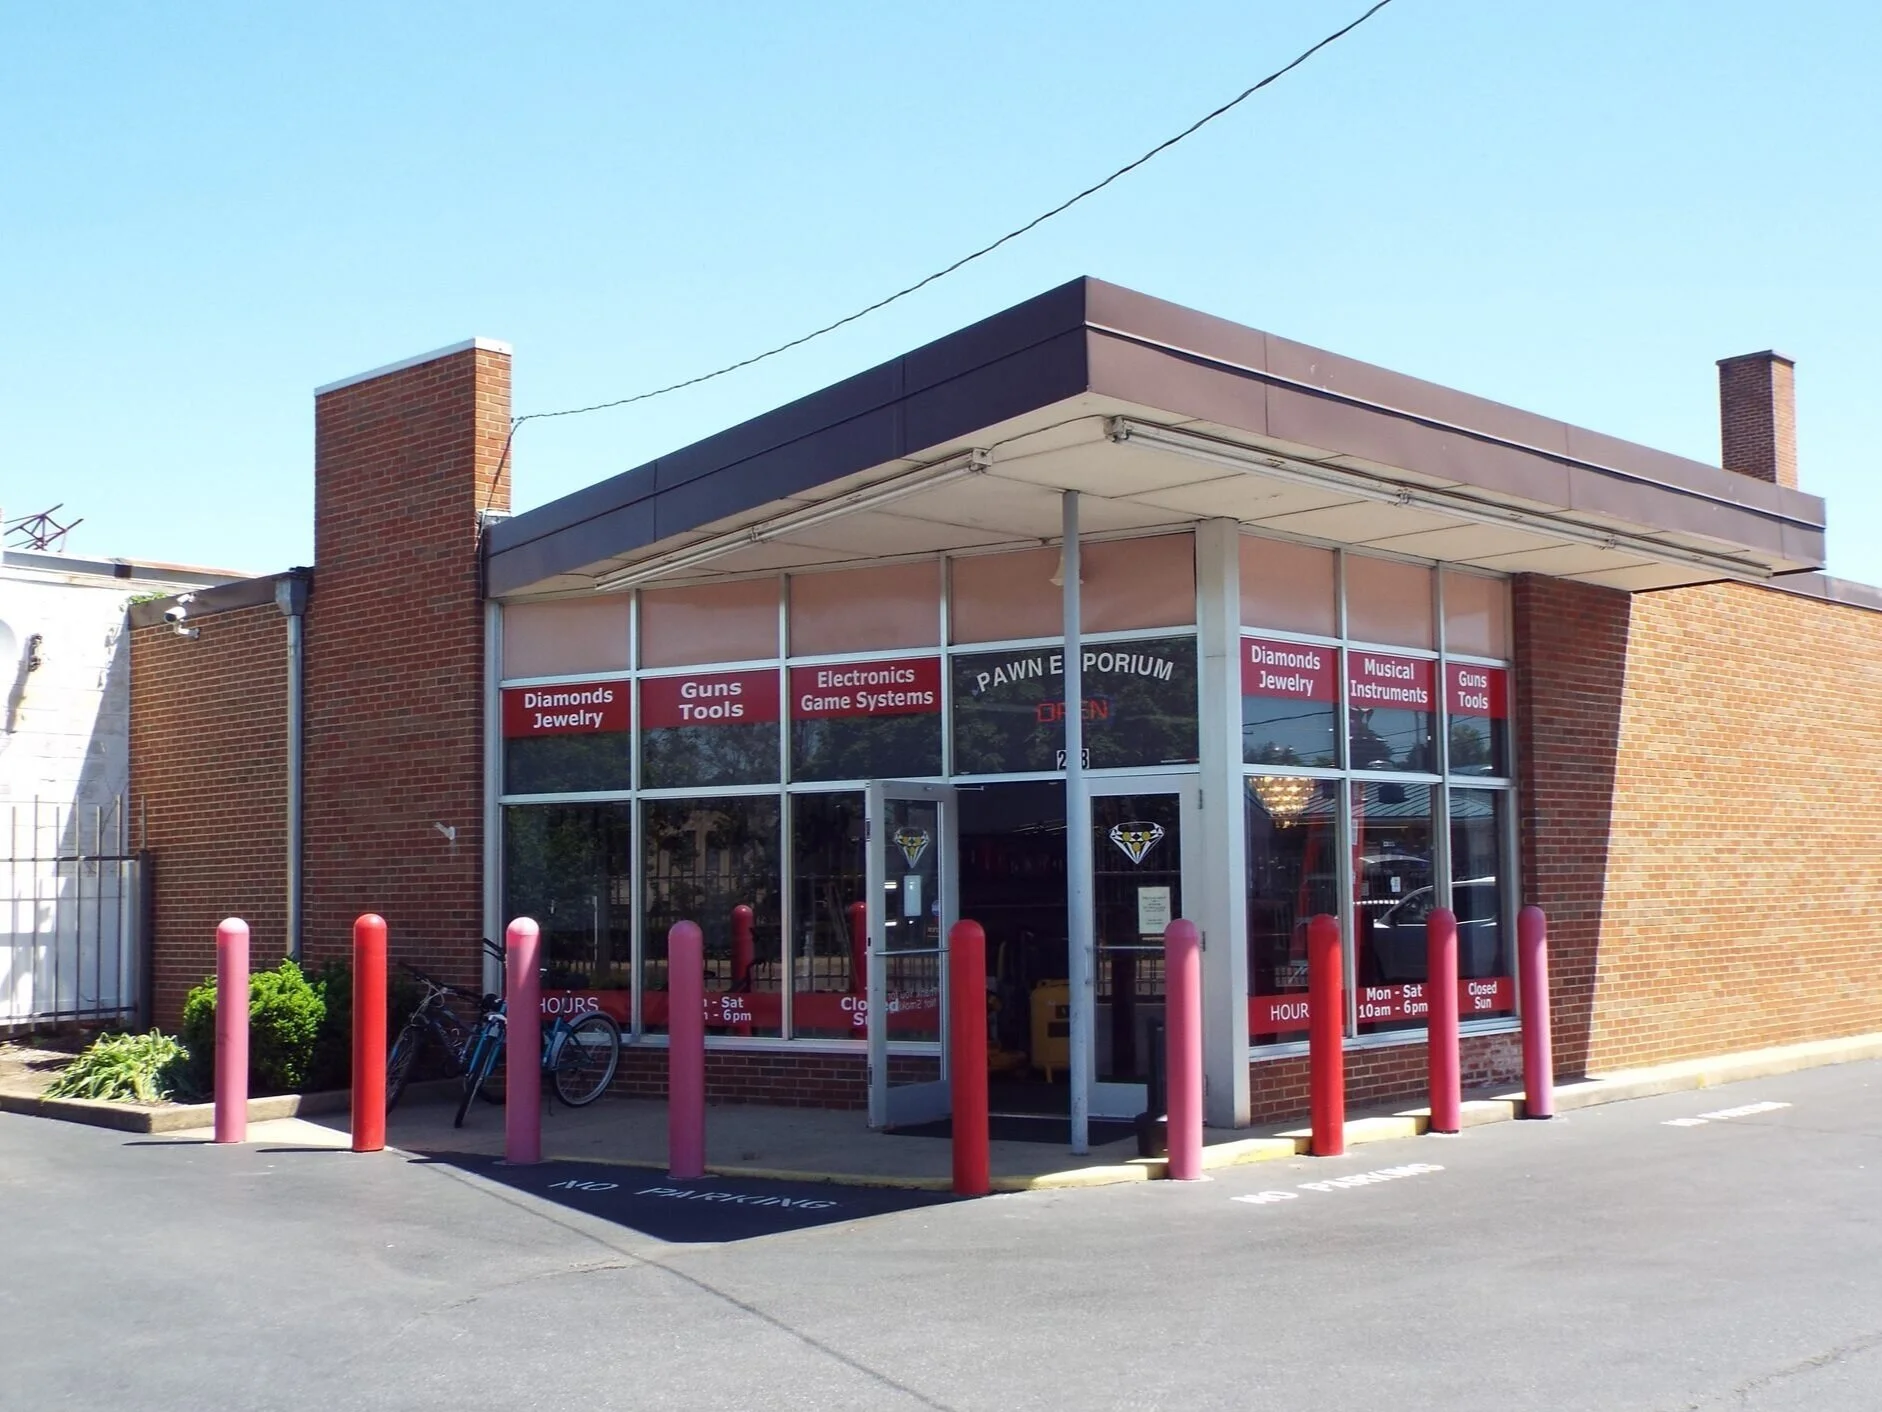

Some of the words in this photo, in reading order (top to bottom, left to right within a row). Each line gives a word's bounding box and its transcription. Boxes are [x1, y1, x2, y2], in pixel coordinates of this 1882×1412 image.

[1251, 645, 1321, 670] Diamonds
[817, 666, 915, 688] Electronics
[976, 657, 1043, 692] PAWN
[1049, 652, 1175, 681] EPORIUM
[1364, 658, 1415, 680] Musical
[1259, 670, 1313, 697] Jewelry
[1458, 671, 1487, 688] Guns
[524, 687, 613, 709] Diamonds
[680, 681, 742, 699] Guns
[1350, 679, 1428, 704] Instruments
[801, 692, 851, 712] Game
[856, 689, 934, 712] Systems
[1458, 691, 1488, 710] Tools
[679, 701, 744, 720] Tools
[533, 711, 604, 730] Jewelry
[1058, 750, 1089, 770] 28
[1366, 987, 1391, 1001] Mon
[1403, 984, 1422, 998] Sat
[1468, 981, 1497, 995] Closed
[721, 996, 744, 1008] Sat
[841, 996, 900, 1013] Clod
[1359, 1004, 1391, 1018] 10am
[1403, 1000, 1428, 1015] 6pm
[1474, 997, 1491, 1009] Sun
[723, 1009, 752, 1023] 6pm
[547, 1180, 620, 1191] NO
[633, 1187, 838, 1209] PARKING
